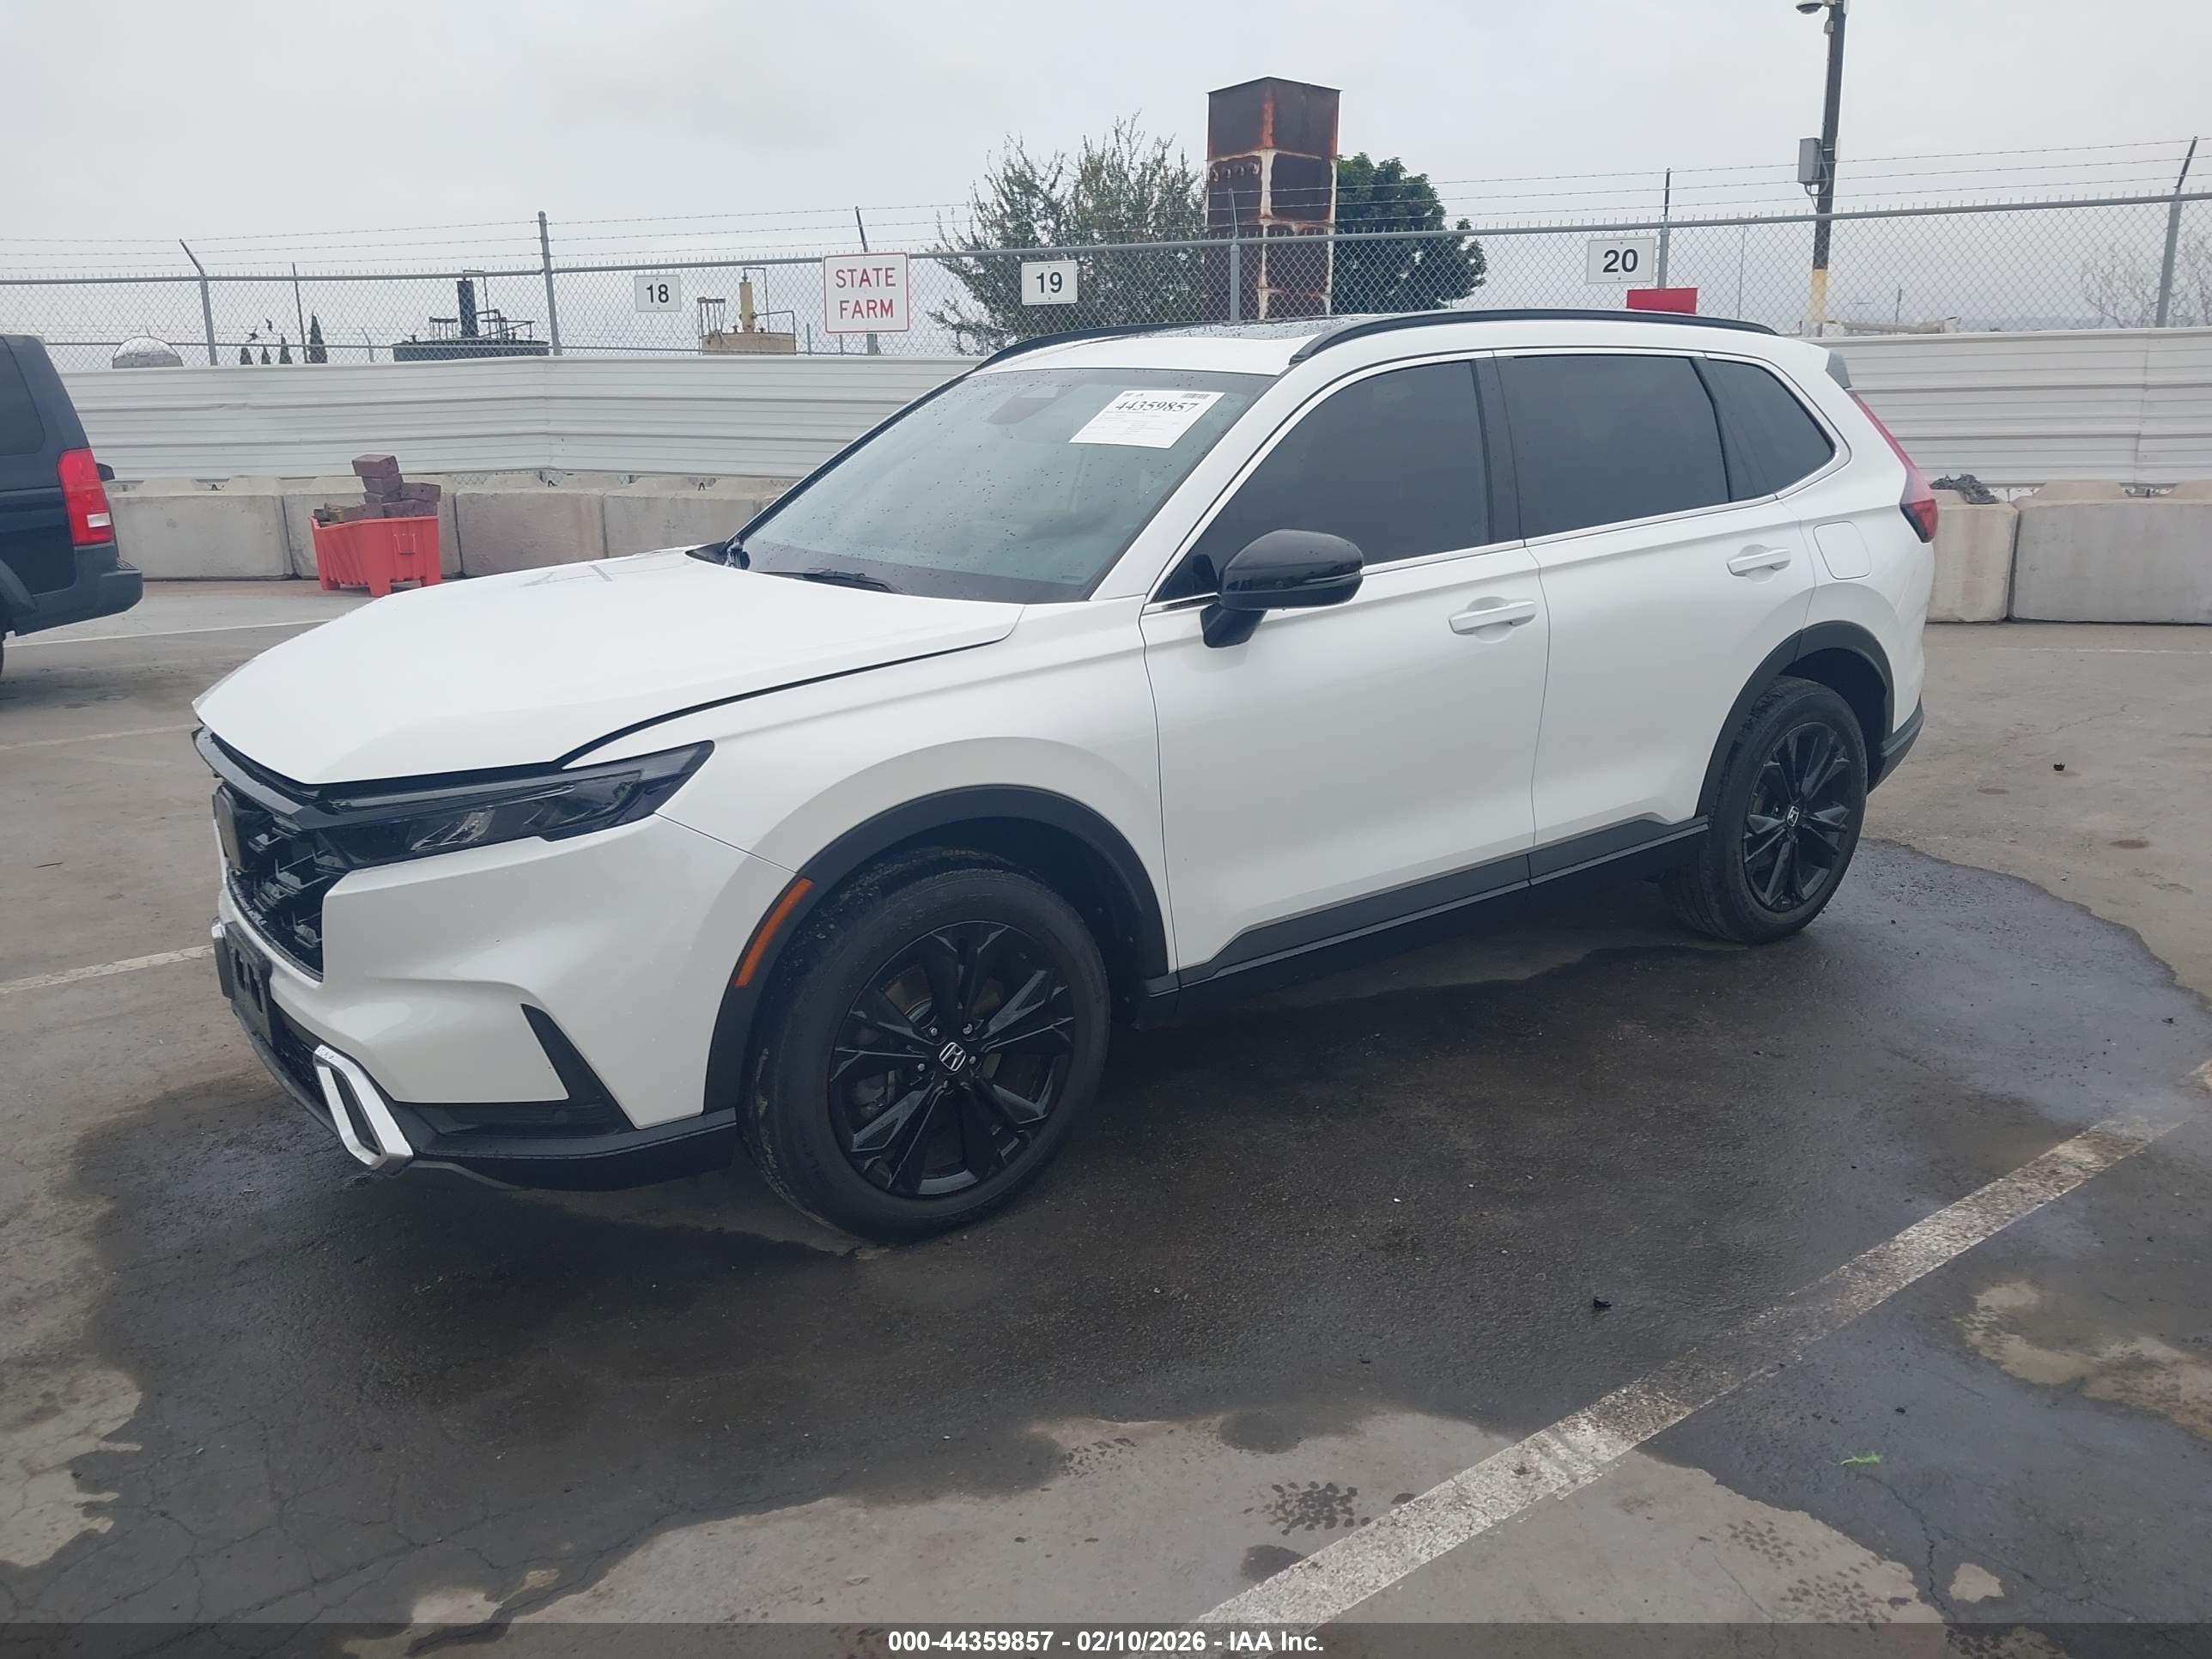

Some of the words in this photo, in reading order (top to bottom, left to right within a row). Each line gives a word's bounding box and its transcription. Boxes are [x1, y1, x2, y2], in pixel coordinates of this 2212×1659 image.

[1602, 248, 1638, 273] 20
[836, 267, 896, 289] STATE
[1036, 271, 1063, 294] 19
[646, 283, 669, 303] 18
[839, 298, 894, 319] FARM
[1115, 400, 1200, 413] 44359857
